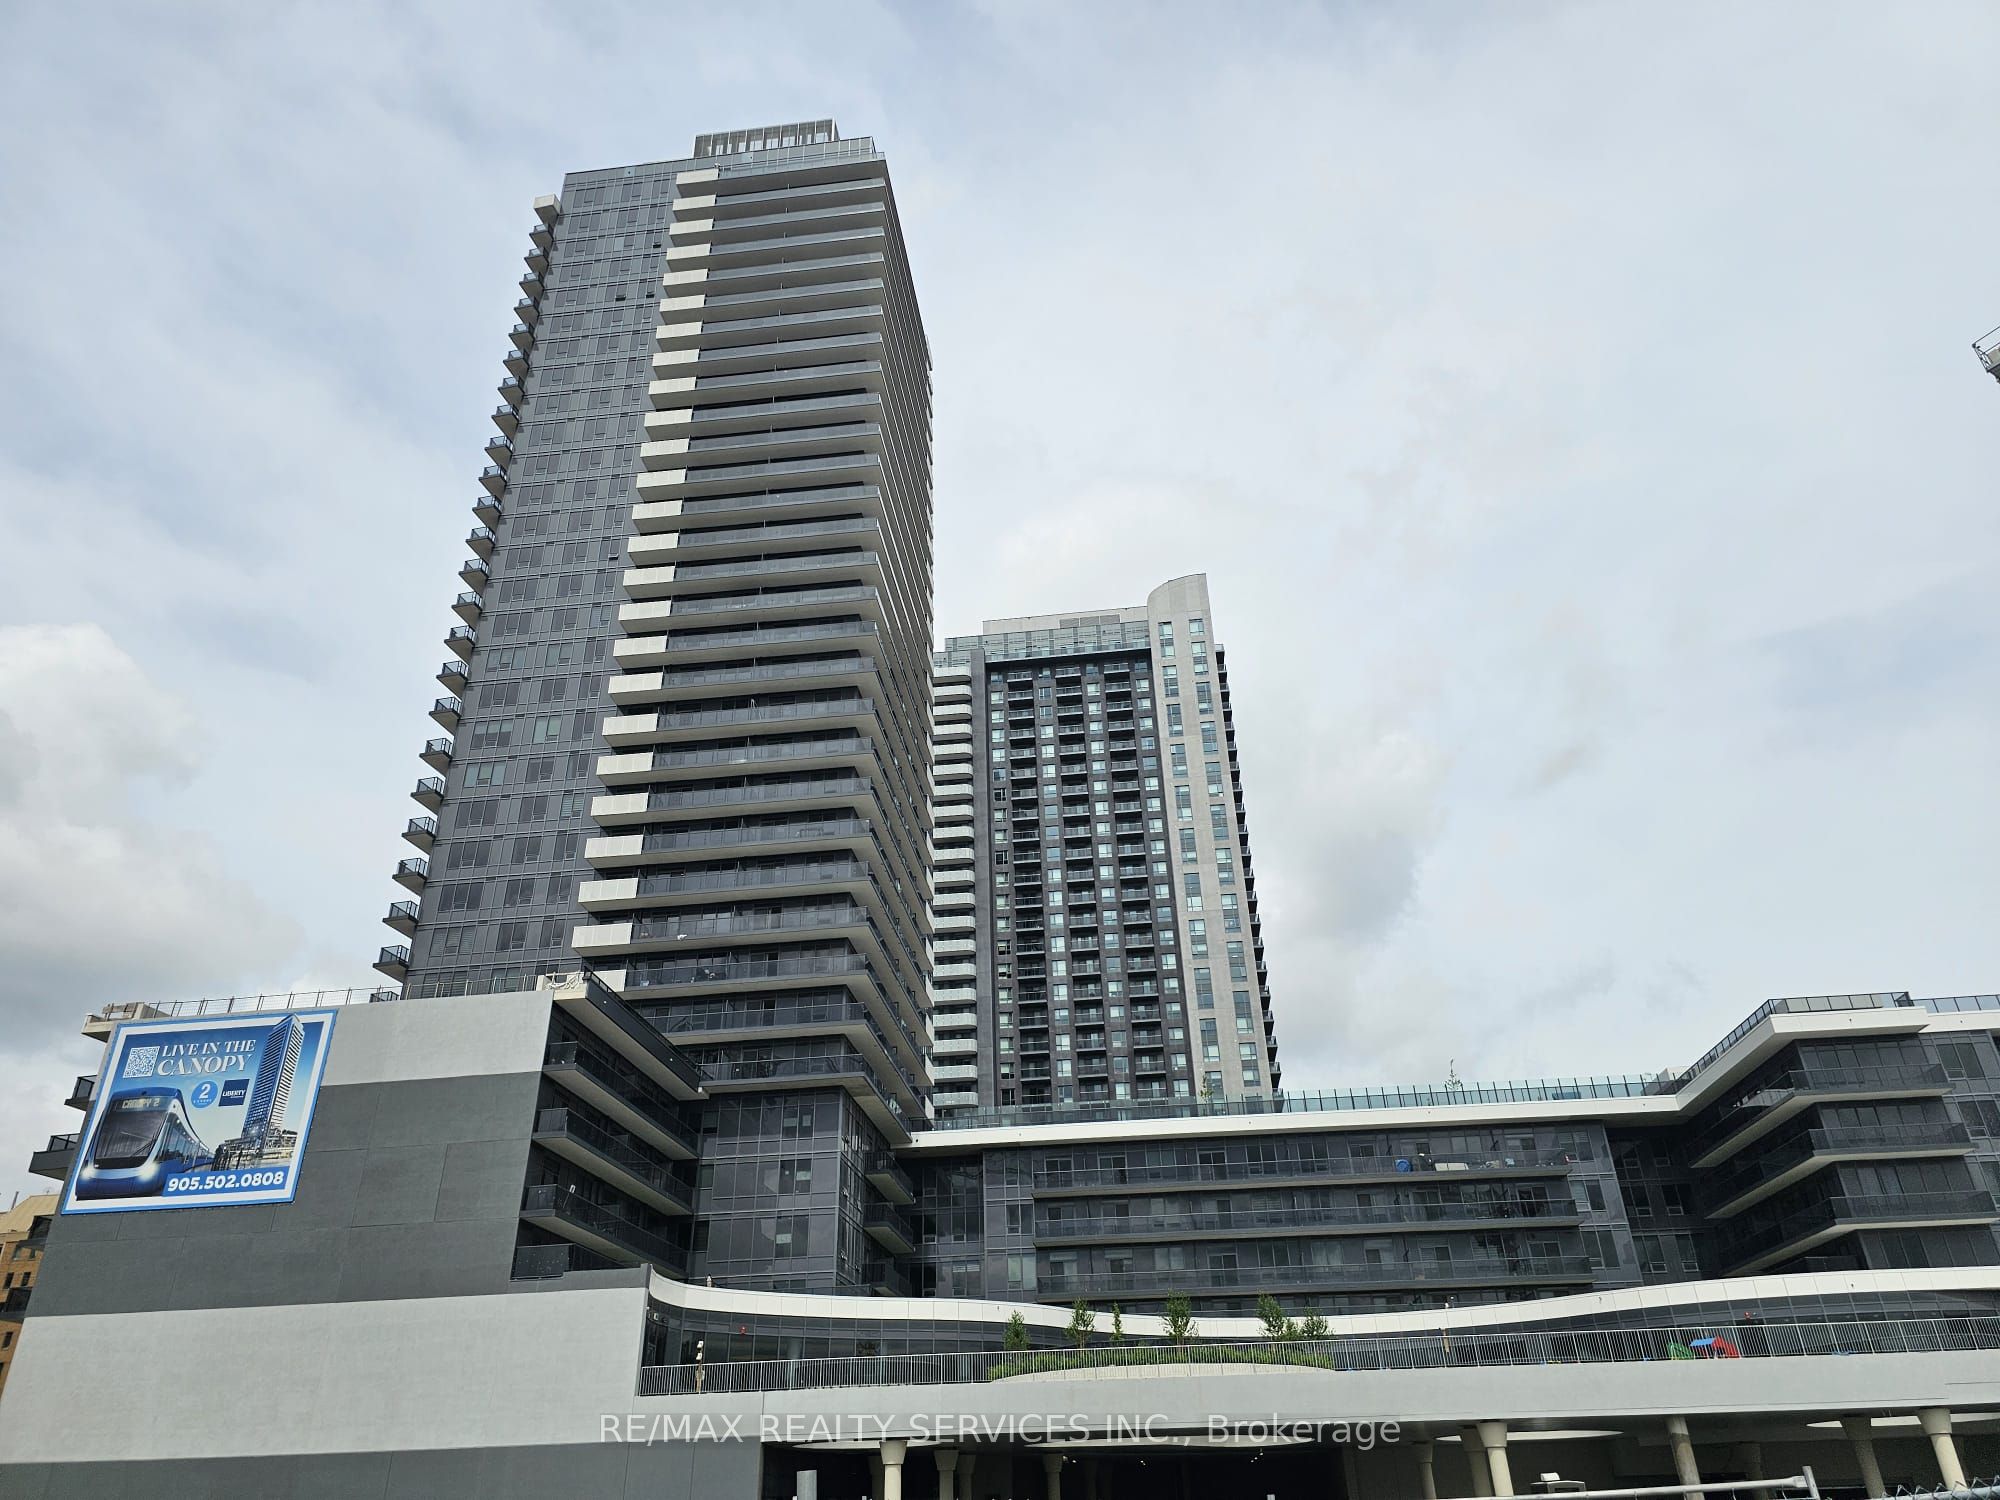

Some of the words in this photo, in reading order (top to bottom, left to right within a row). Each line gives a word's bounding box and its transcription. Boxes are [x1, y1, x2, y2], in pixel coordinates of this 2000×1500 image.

[162, 1044, 198, 1056] LIVE
[202, 1042, 221, 1054] IN
[224, 1039, 256, 1053] THE
[157, 1054, 251, 1076] CANOPY
[200, 1083, 210, 1099] 2
[167, 1171, 285, 1192] 905.502.0808
